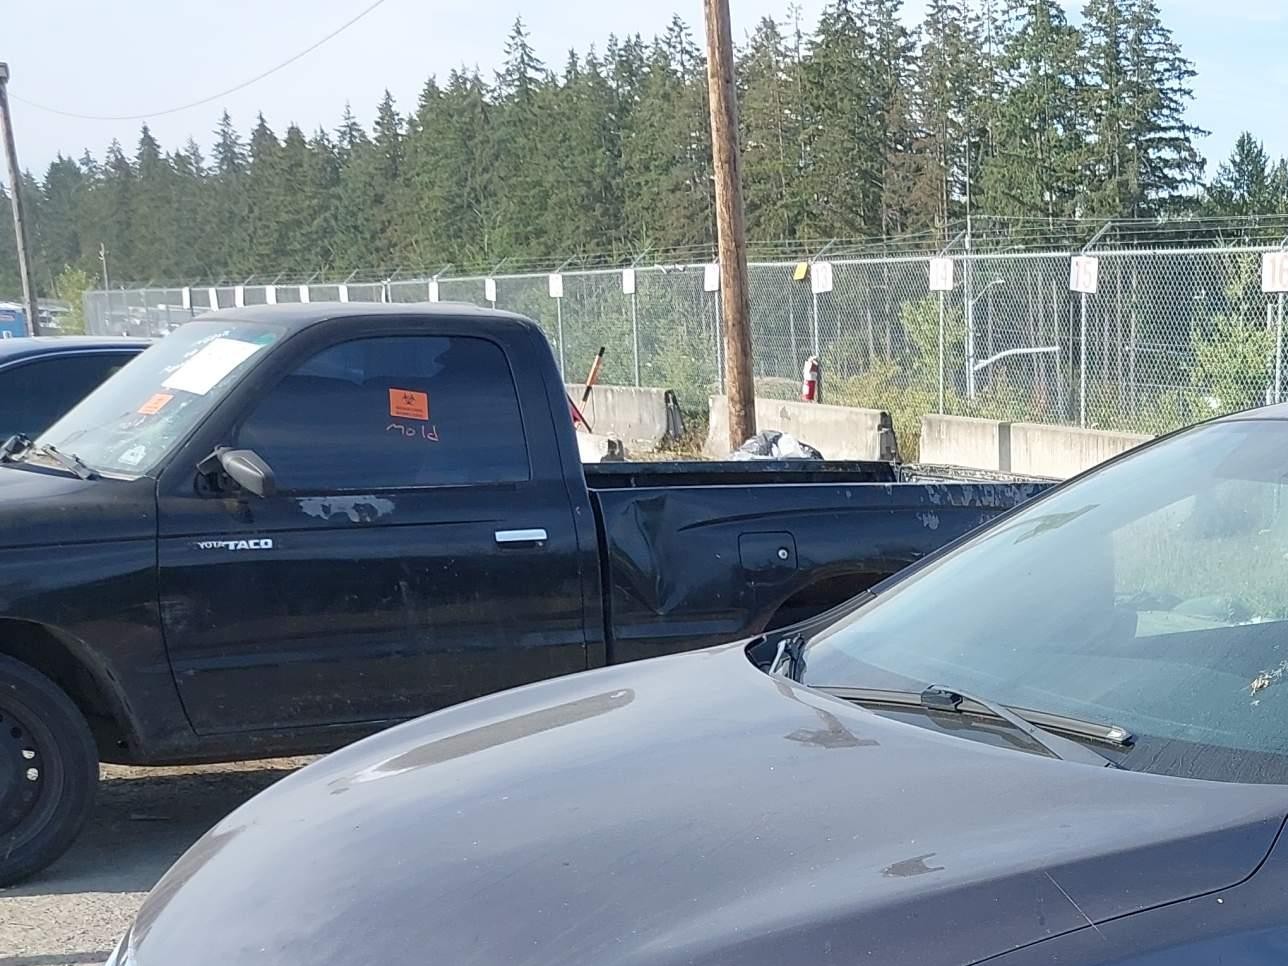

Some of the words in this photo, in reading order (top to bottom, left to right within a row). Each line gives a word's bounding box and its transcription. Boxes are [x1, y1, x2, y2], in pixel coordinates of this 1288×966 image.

[815, 265, 829, 289] 13
[1075, 260, 1092, 289] 15
[223, 538, 272, 550] TACO
